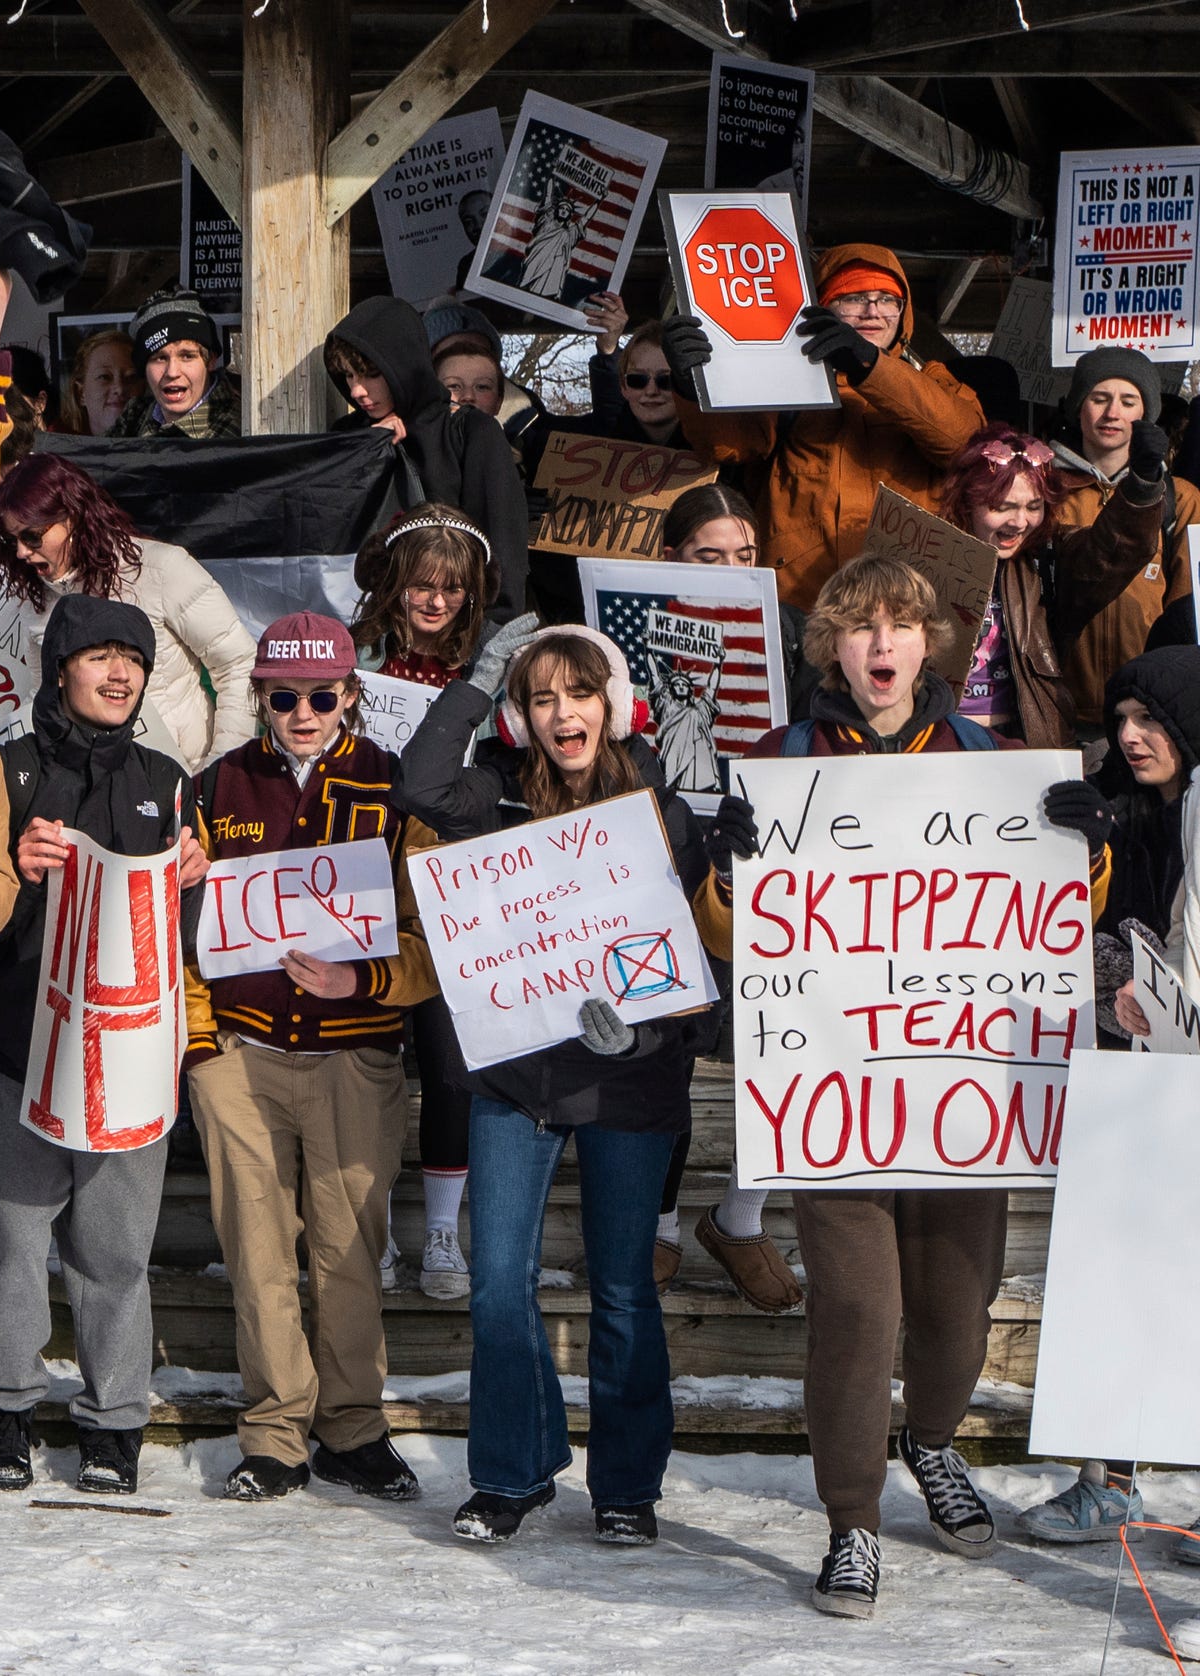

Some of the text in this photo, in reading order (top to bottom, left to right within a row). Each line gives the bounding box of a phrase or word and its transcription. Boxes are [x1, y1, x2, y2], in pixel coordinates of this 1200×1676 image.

[720, 75, 798, 103] To ignore evil
[720, 92, 796, 119] is to become
[719, 113, 786, 135] accomplice
[719, 130, 733, 142] to
[409, 141, 446, 161] TIME
[450, 139, 462, 152] IS
[395, 159, 450, 183] ALWAYS
[456, 147, 494, 167] RIGHT
[555, 160, 605, 196] IMMIGRANTS
[565, 148, 609, 183] WE ARE ALL
[384, 166, 488, 201] TO DO WHAT IS
[1080, 174, 1194, 203] THIS IS NOT A
[405, 193, 458, 217] RIGHT.
[1078, 200, 1194, 226] LEFT OR RIGHT
[195, 220, 238, 232] INJUST
[195, 234, 242, 246] ANYWHE
[1093, 224, 1178, 252] MOMENT
[195, 248, 242, 261] IS A THR
[195, 262, 242, 275] TO JUSTI
[696, 243, 787, 275] STOP
[195, 277, 242, 289] EVERYW
[1080, 263, 1187, 290] IT'S A RIGHT
[719, 276, 779, 308] ICE
[1083, 288, 1183, 316] OR WRONG
[145, 327, 169, 349] SRSLY
[1088, 314, 1174, 340] MOMENT
[555, 439, 707, 497] STOP
[540, 487, 668, 558] KIDNAPPIN
[872, 492, 976, 573] NO ONE IS
[655, 614, 716, 642] WE ARE ALL
[267, 639, 335, 659] DEER TICK
[651, 630, 719, 658] IMMIGRANTS
[736, 770, 1037, 858] We are
[212, 814, 264, 843] Henry
[426, 846, 533, 902] Prison
[206, 855, 382, 953] ICE OUT
[440, 862, 630, 941] Due process is
[750, 868, 1088, 958] SKIPPING
[536, 911, 556, 923] a
[460, 915, 628, 979] concentration
[491, 958, 595, 1009] CAMP
[740, 959, 1078, 1000] our lessons
[752, 1001, 1077, 1059] to TEACH
[745, 1071, 906, 1173] YOU
